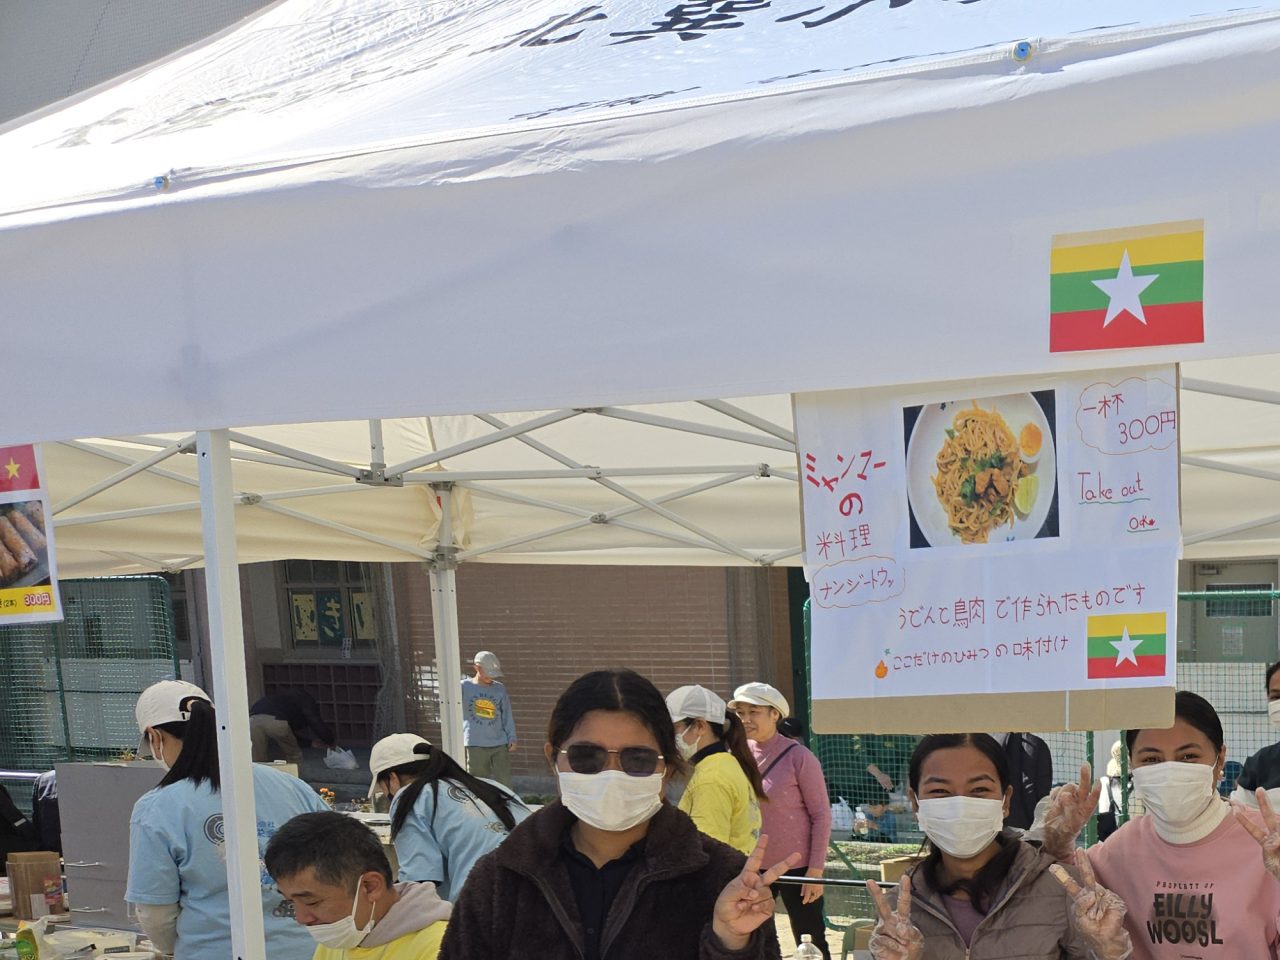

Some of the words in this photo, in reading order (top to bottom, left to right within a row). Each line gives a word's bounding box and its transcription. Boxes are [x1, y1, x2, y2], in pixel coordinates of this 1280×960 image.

[1083, 393, 1124, 419] 一杯
[1118, 410, 1176, 445] 300円
[806, 450, 886, 492] ミャンマー
[1077, 471, 1113, 500] Take
[1121, 472, 1144, 497] out
[839, 492, 863, 516] の
[816, 523, 871, 560] 料理
[24, 593, 51, 607] 300円
[1156, 881, 1200, 890] PROPERTY
[1147, 919, 1223, 948] WOOSL
